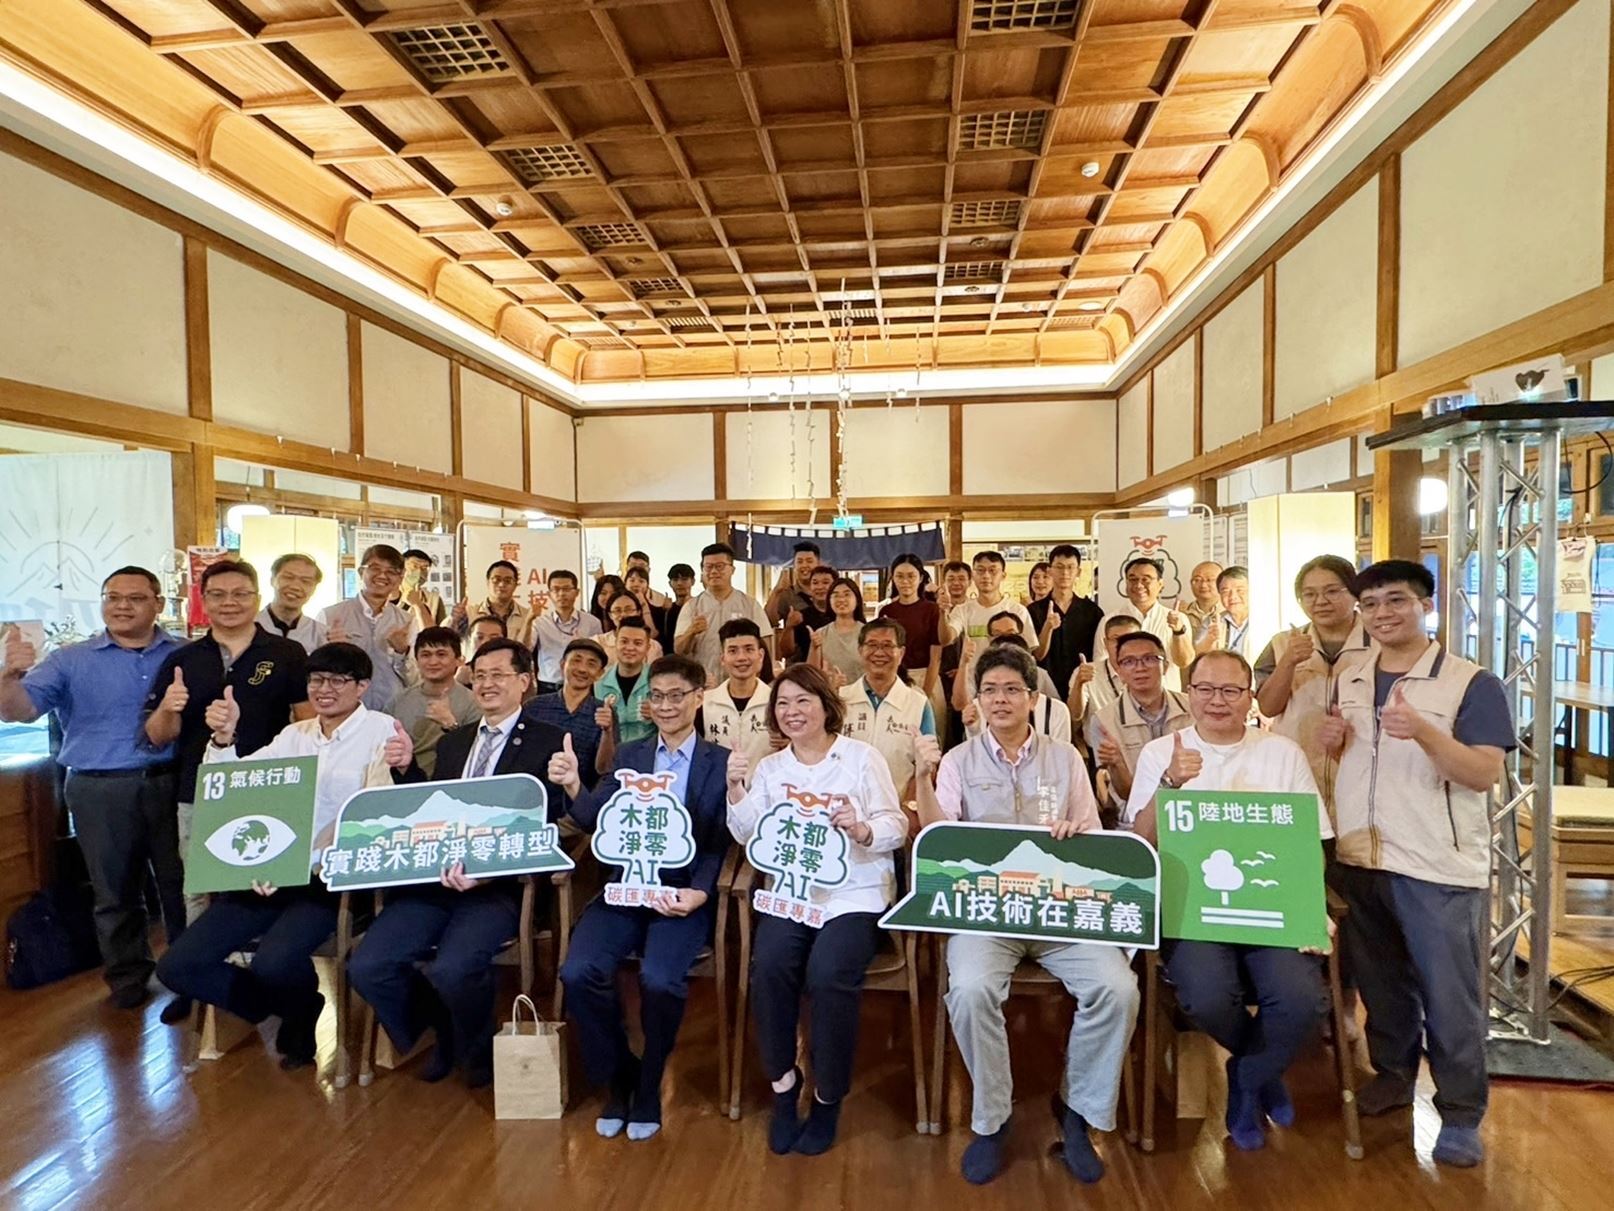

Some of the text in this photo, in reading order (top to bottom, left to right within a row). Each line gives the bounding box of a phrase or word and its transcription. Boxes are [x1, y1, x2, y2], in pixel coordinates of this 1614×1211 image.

[203, 765, 302, 801] 13 氣候行動
[619, 803, 669, 831] 木都
[776, 814, 828, 849] 木都
[1164, 800, 1294, 833] 15 陸地生態
[327, 830, 553, 877] 實踐木都淨零轉型
[618, 830, 668, 857] 淨零
[772, 839, 824, 875] 淨零
[624, 859, 659, 886] AI
[774, 870, 812, 902] AI
[755, 890, 825, 926] 碳匯專嘉
[929, 890, 1143, 935] AI技術在嘉義
